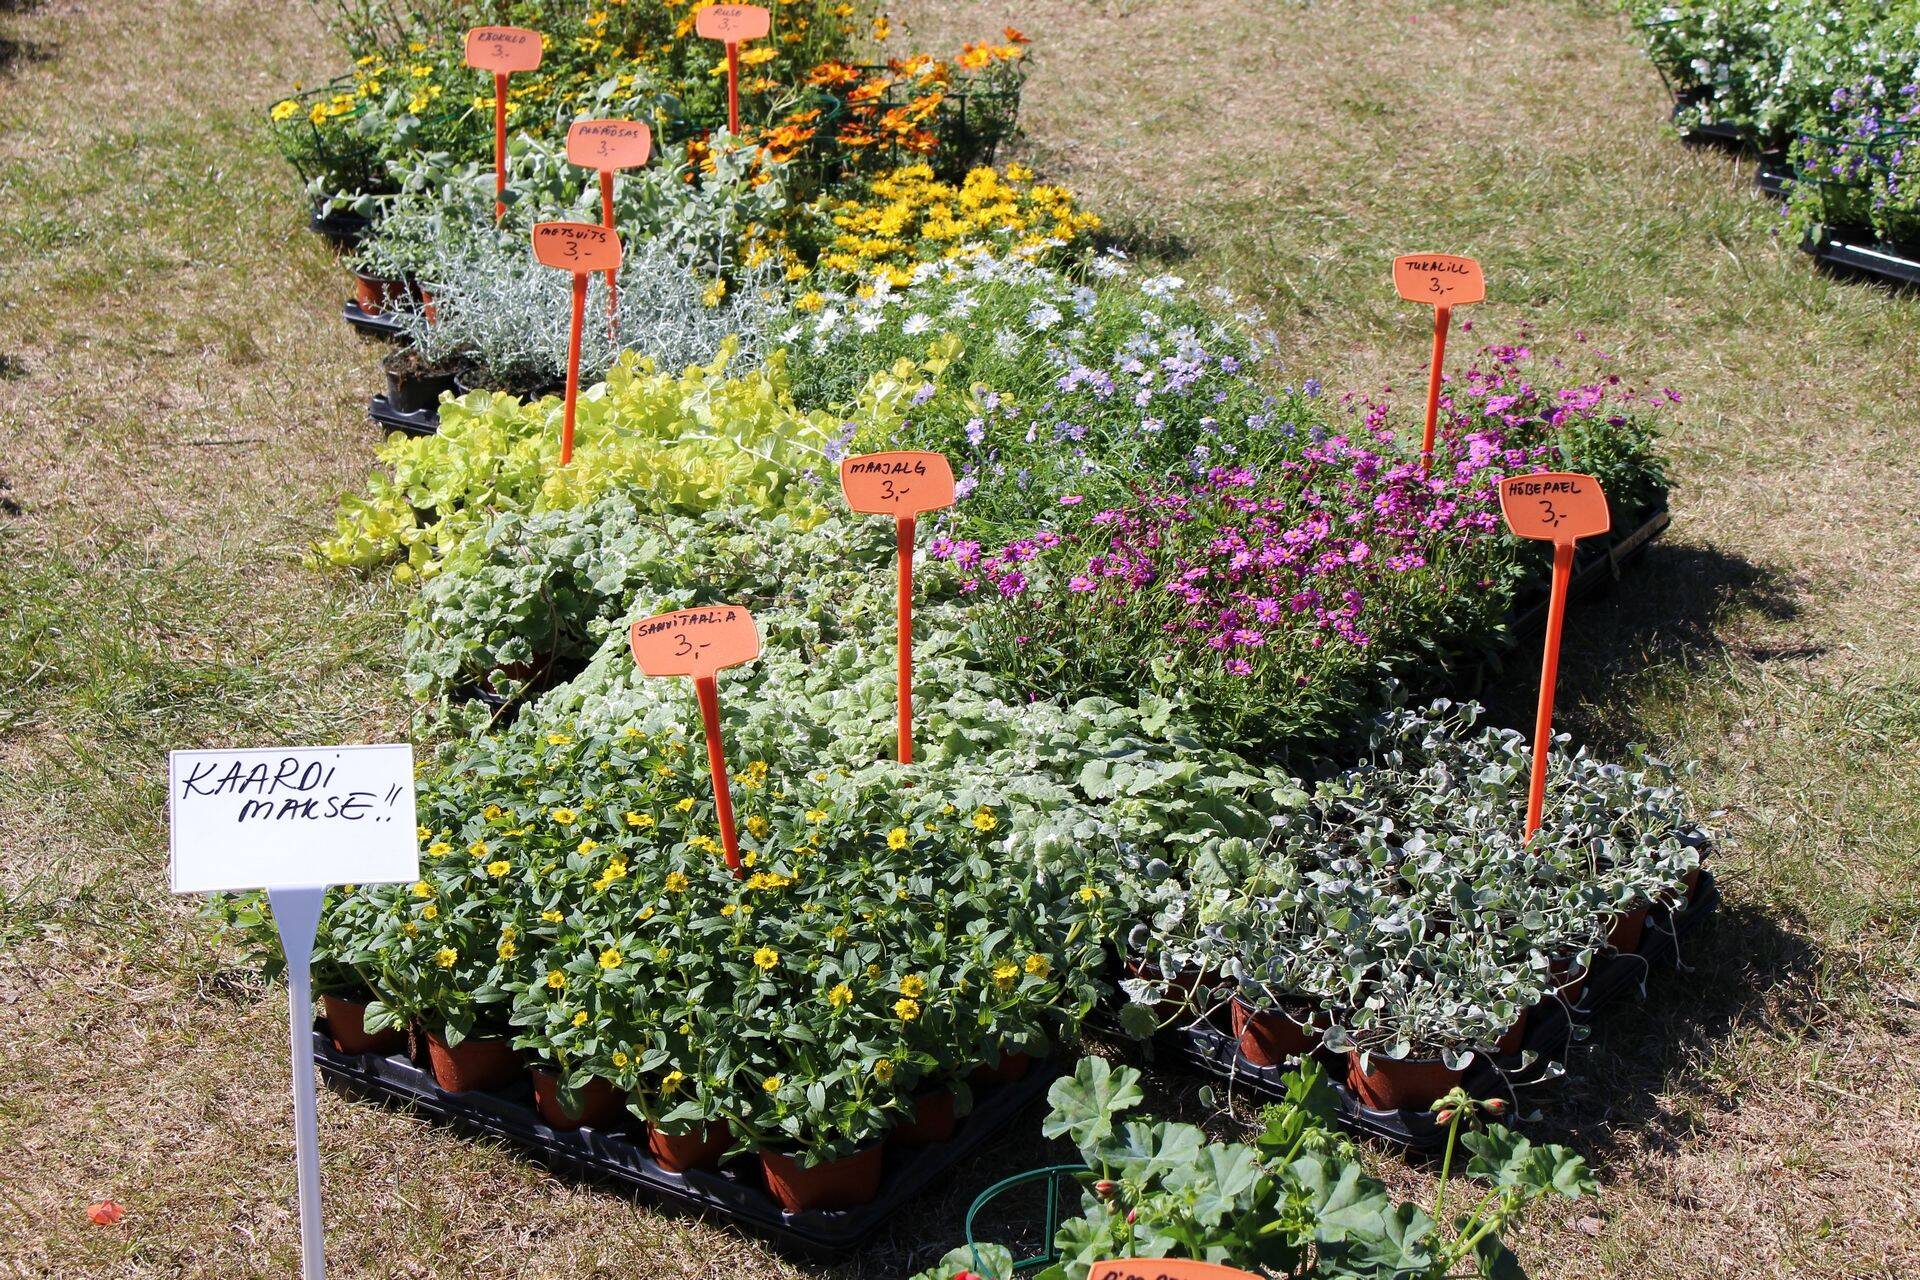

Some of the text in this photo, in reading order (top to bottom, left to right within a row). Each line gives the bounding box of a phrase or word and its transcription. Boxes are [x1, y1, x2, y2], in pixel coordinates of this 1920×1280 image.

[563, 241, 592, 260] 3,-
[1429, 277, 1454, 295] 3,-
[850, 461, 926, 476] MAAJALG
[881, 480, 910, 502] 3,-
[1539, 500, 1567, 527] 3,-
[674, 634, 711, 659] 3,-
